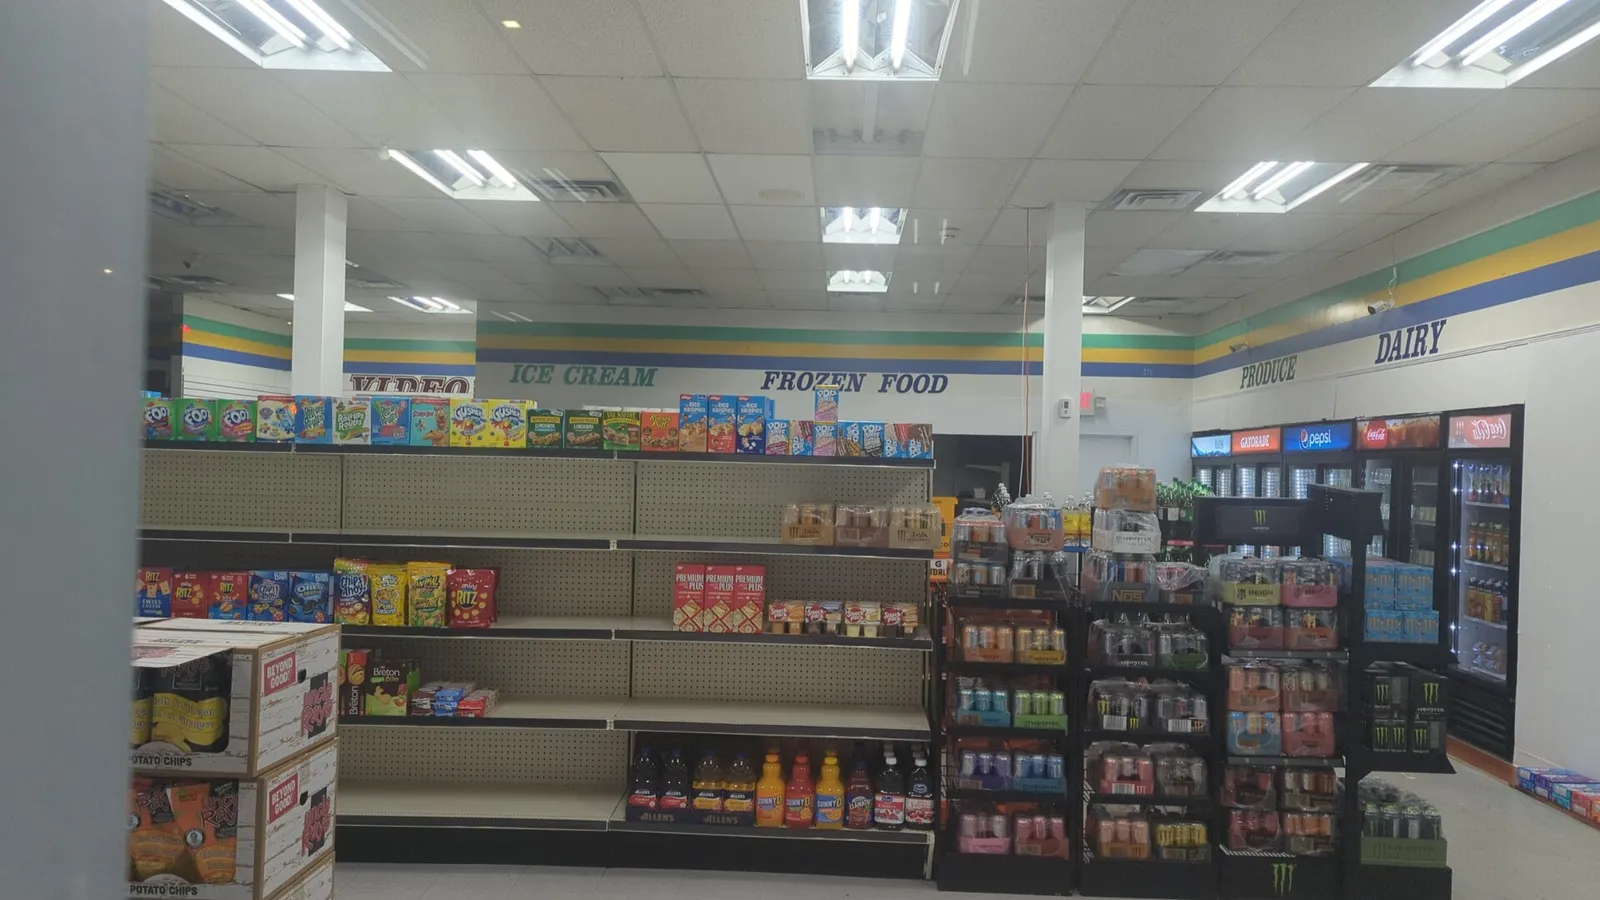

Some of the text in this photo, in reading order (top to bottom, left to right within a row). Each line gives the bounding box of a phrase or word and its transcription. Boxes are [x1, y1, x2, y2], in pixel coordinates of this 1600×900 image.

[1375, 319, 1447, 364] DAIRY
[510, 364, 658, 387] ICE CREAM
[1240, 354, 1297, 389] PRODUCE
[350, 374, 470, 393] VIDEO
[760, 371, 948, 394] FROZEN FOOD
[1240, 434, 1270, 448] GATORADE
[1309, 429, 1331, 447] pepsi
[145, 571, 160, 581] RITZ
[676, 574, 704, 583] PREMIUM
[705, 574, 734, 583] PREMIUM
[735, 575, 763, 584] PREMIUM
[220, 582, 234, 592] RITZ
[689, 581, 704, 590] PLUS
[719, 582, 734, 591] PLUS
[748, 583, 763, 592] PLUS
[176, 587, 192, 598] RITZ
[456, 590, 478, 605] RITZ
[1112, 589, 1145, 602] NOS
[1248, 588, 1274, 597] REIGN
[267, 657, 293, 679] BEYOND
[373, 667, 400, 677] Breton
[349, 686, 358, 715] Breton
[164, 756, 192, 766] CHIPS
[271, 780, 296, 806] BEYOND
[129, 884, 198, 896] POTATO CHIPS
